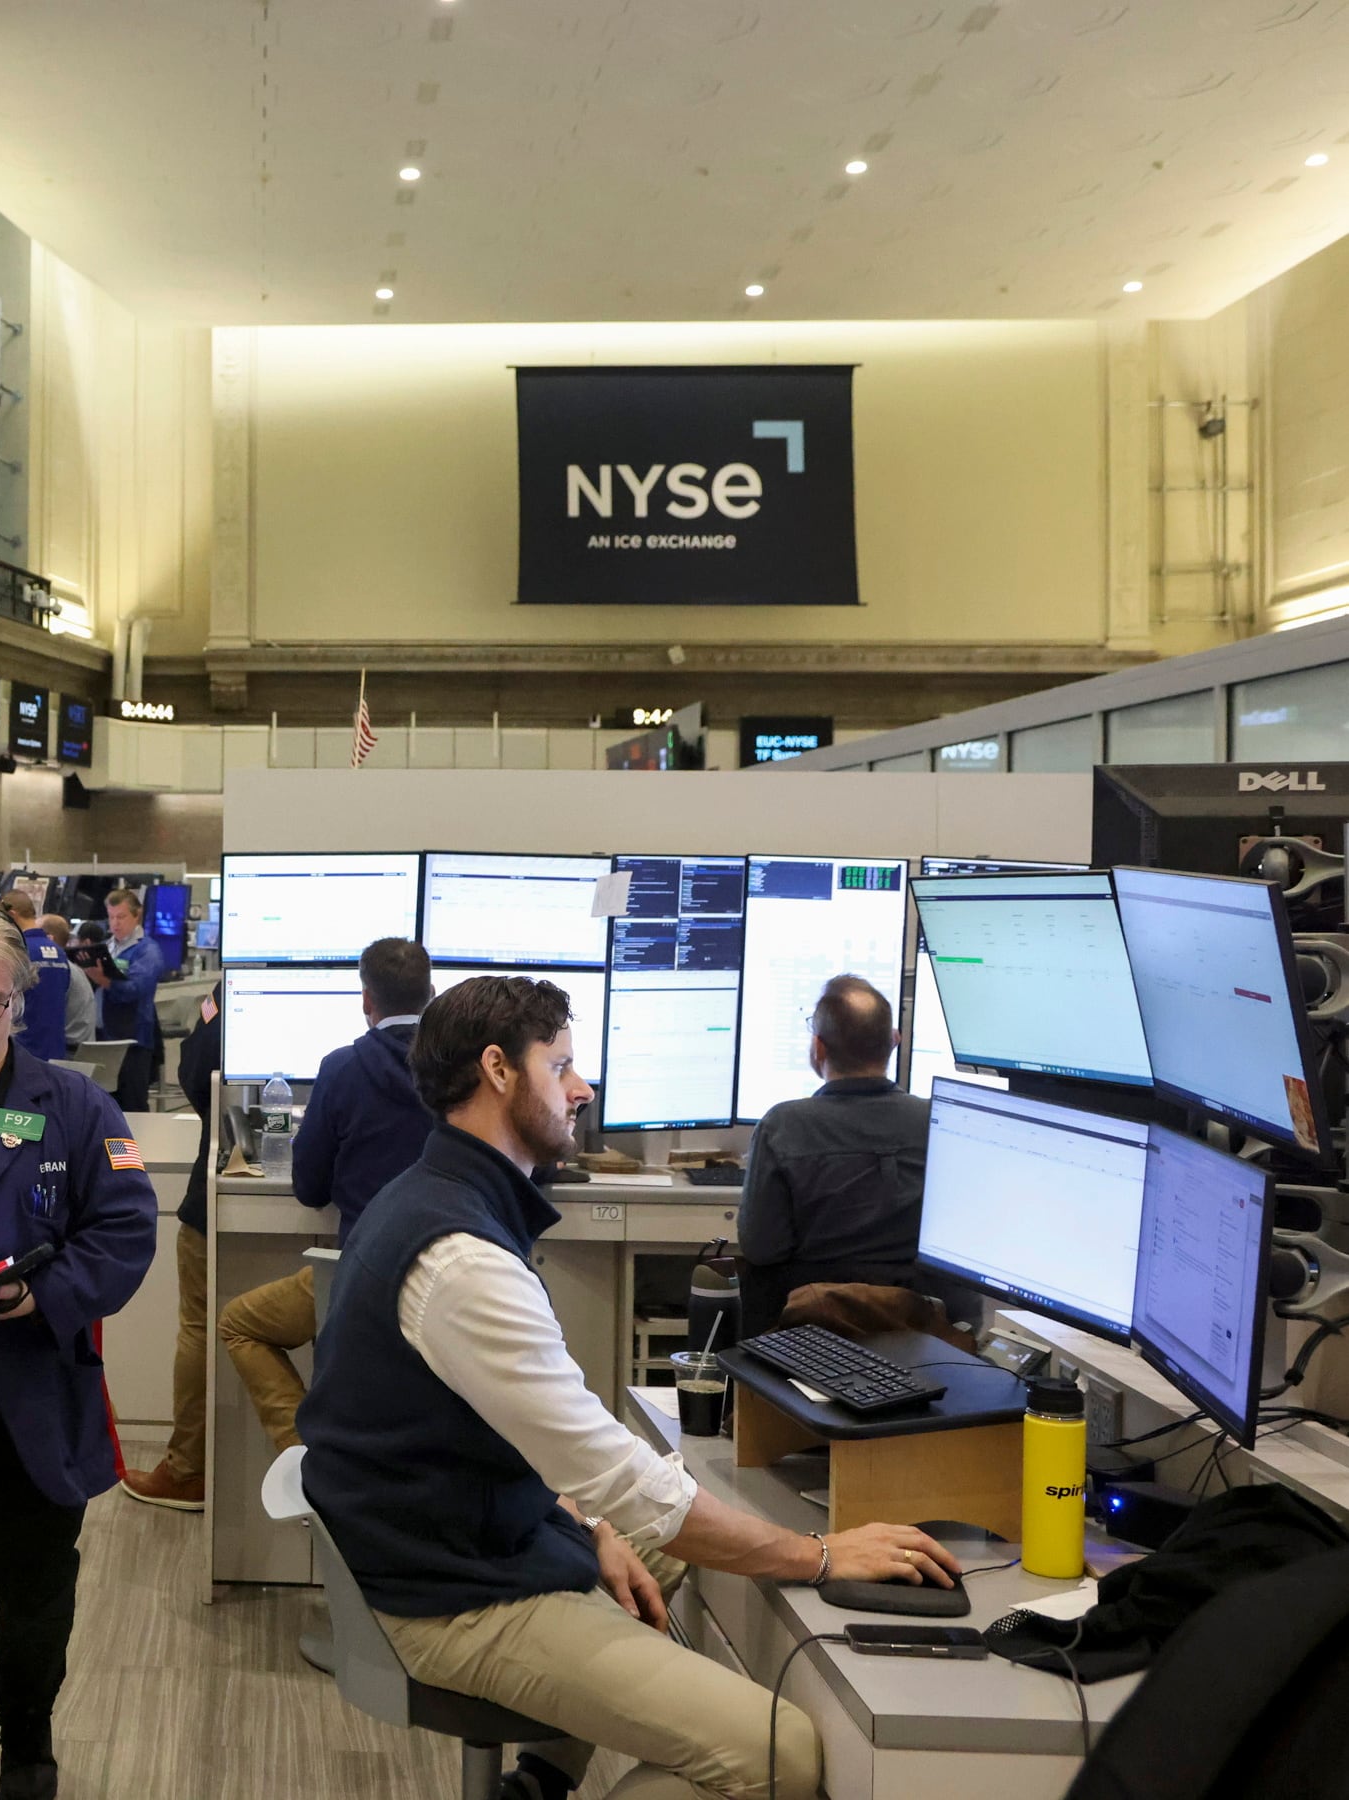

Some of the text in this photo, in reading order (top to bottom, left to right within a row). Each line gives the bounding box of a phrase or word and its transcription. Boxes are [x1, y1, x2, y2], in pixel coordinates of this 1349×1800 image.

[588, 534, 610, 549] AN
[121, 701, 174, 720] 9:44:44
[1238, 771, 1326, 792] DELL
[4, 1113, 32, 1126] F97
[596, 1206, 619, 1219] 170
